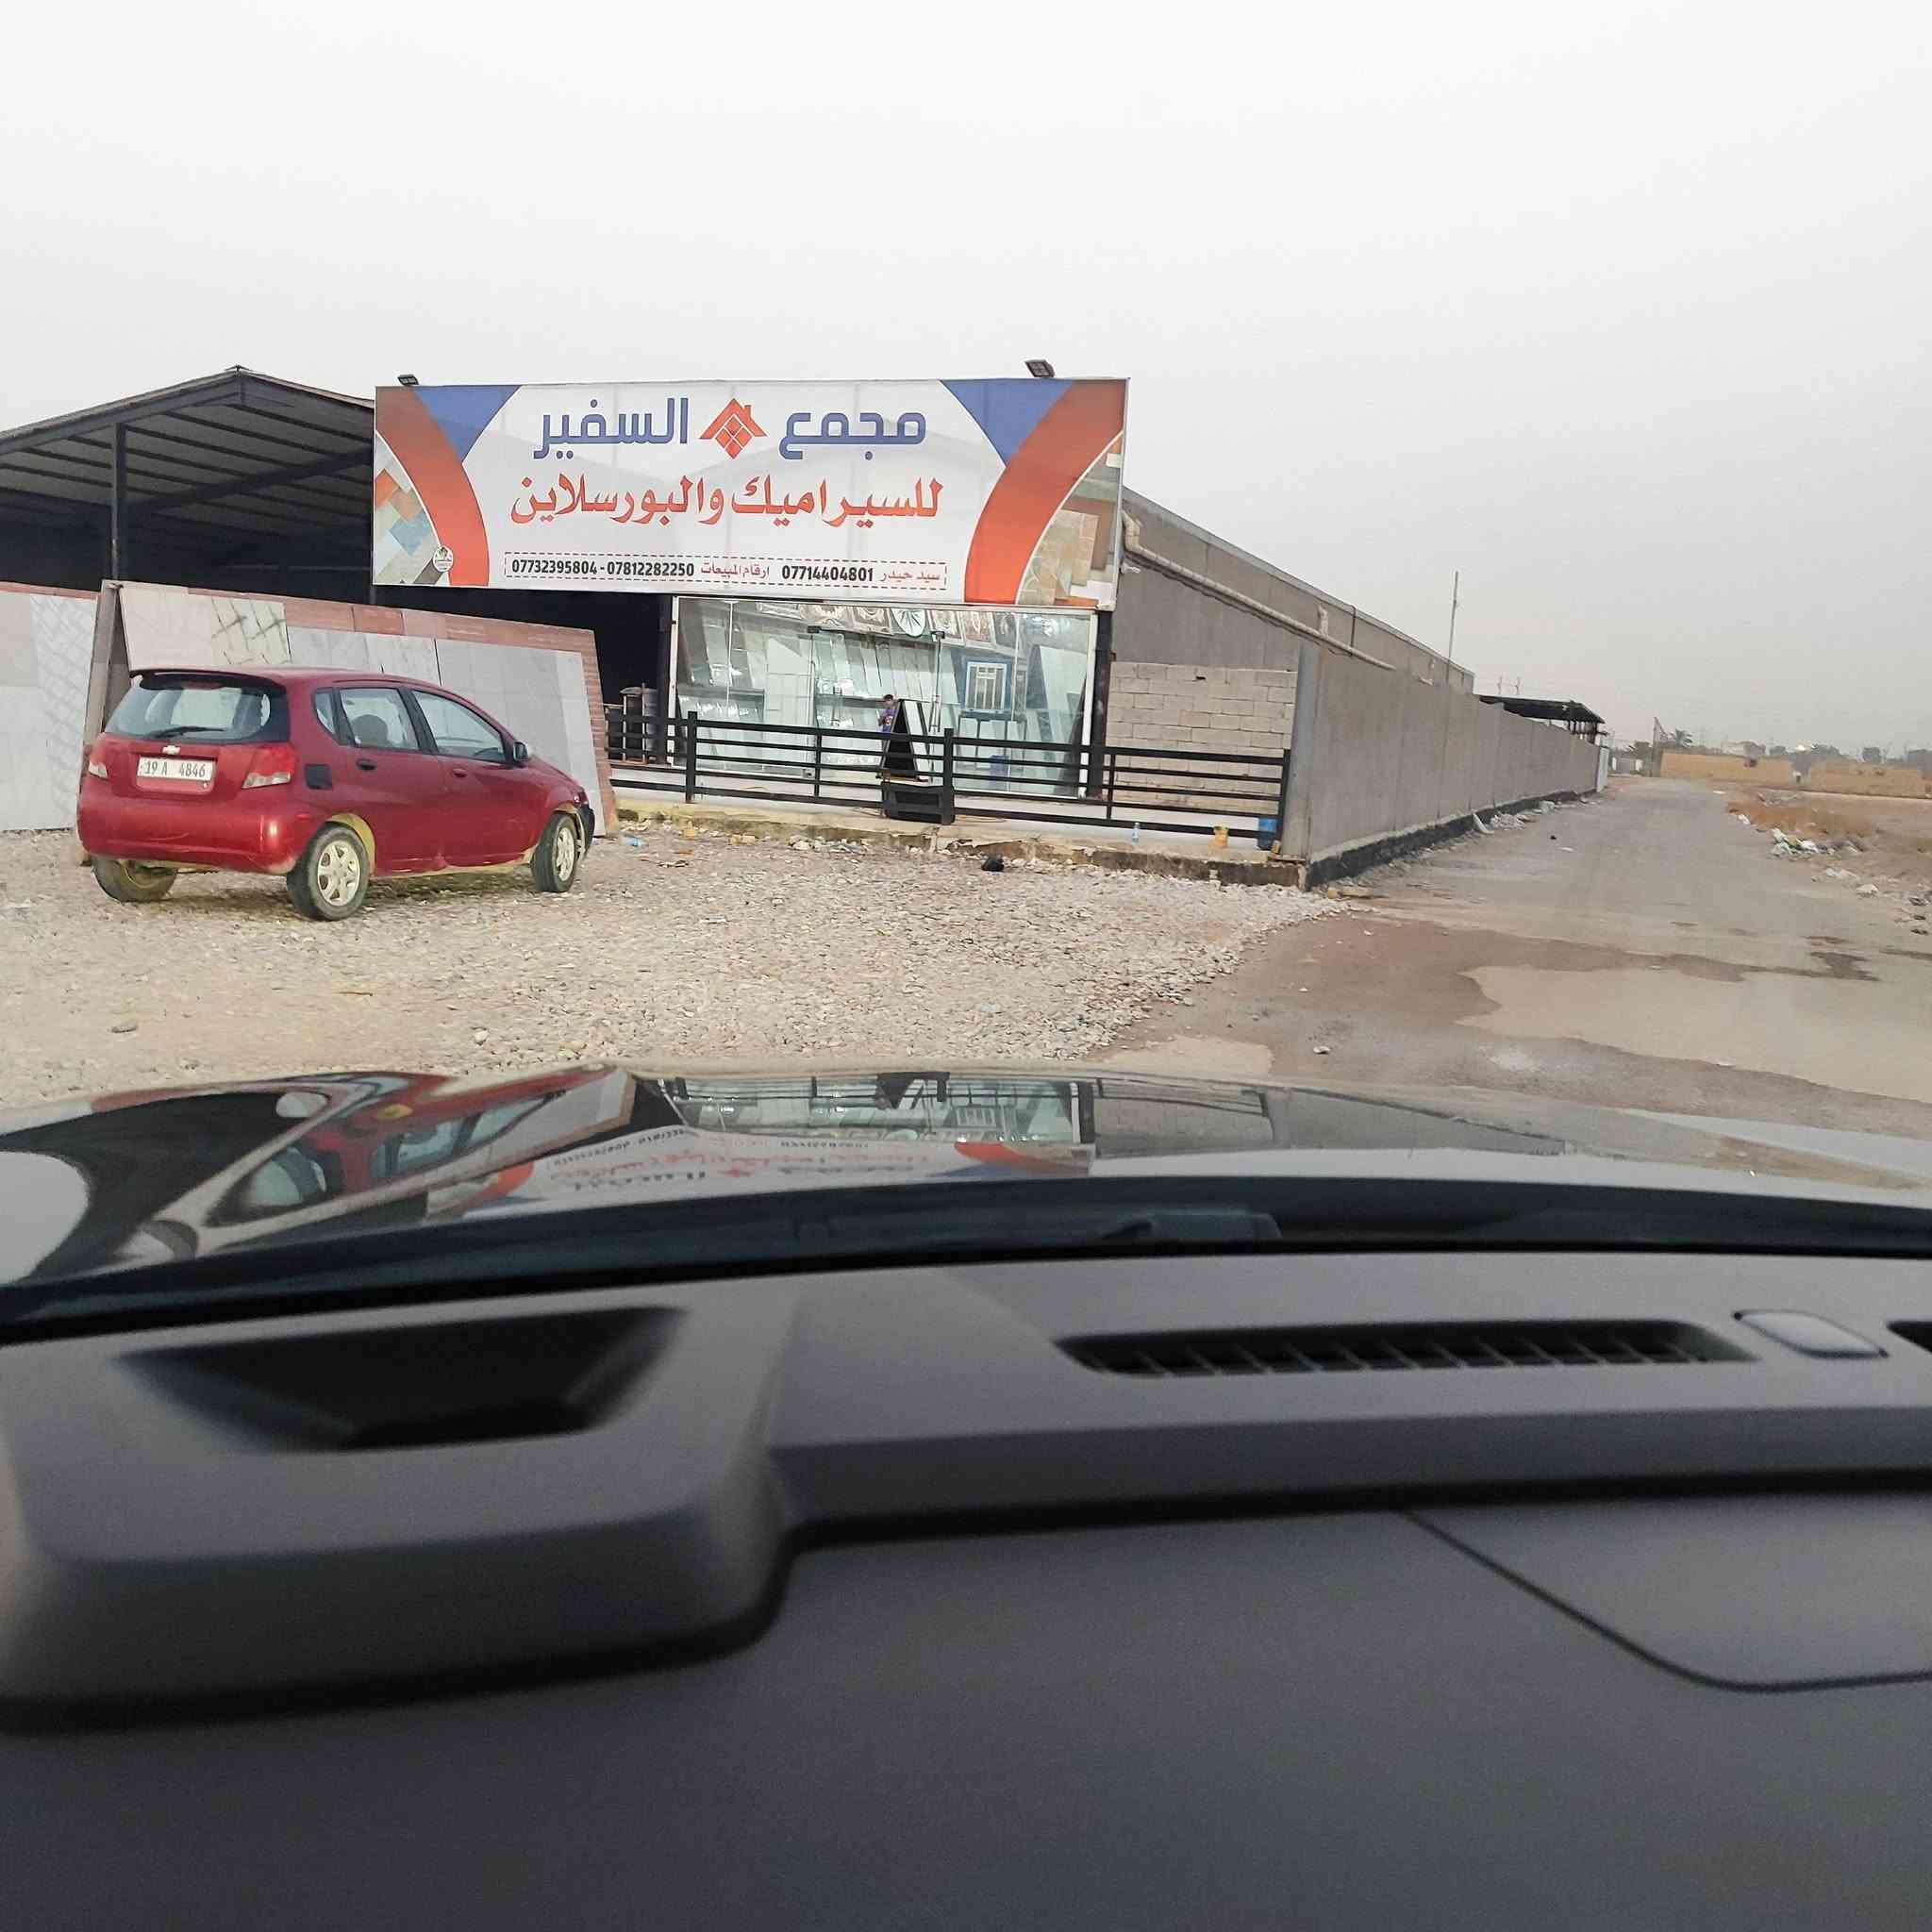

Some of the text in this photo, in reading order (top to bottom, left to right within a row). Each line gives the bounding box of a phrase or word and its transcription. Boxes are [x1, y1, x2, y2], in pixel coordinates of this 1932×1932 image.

[532, 396, 926, 461] مجمع السفير
[510, 473, 943, 529] للسيراميك والبورسلاين
[781, 565, 874, 582] 07714404801
[179, 762, 206, 777] 4846
